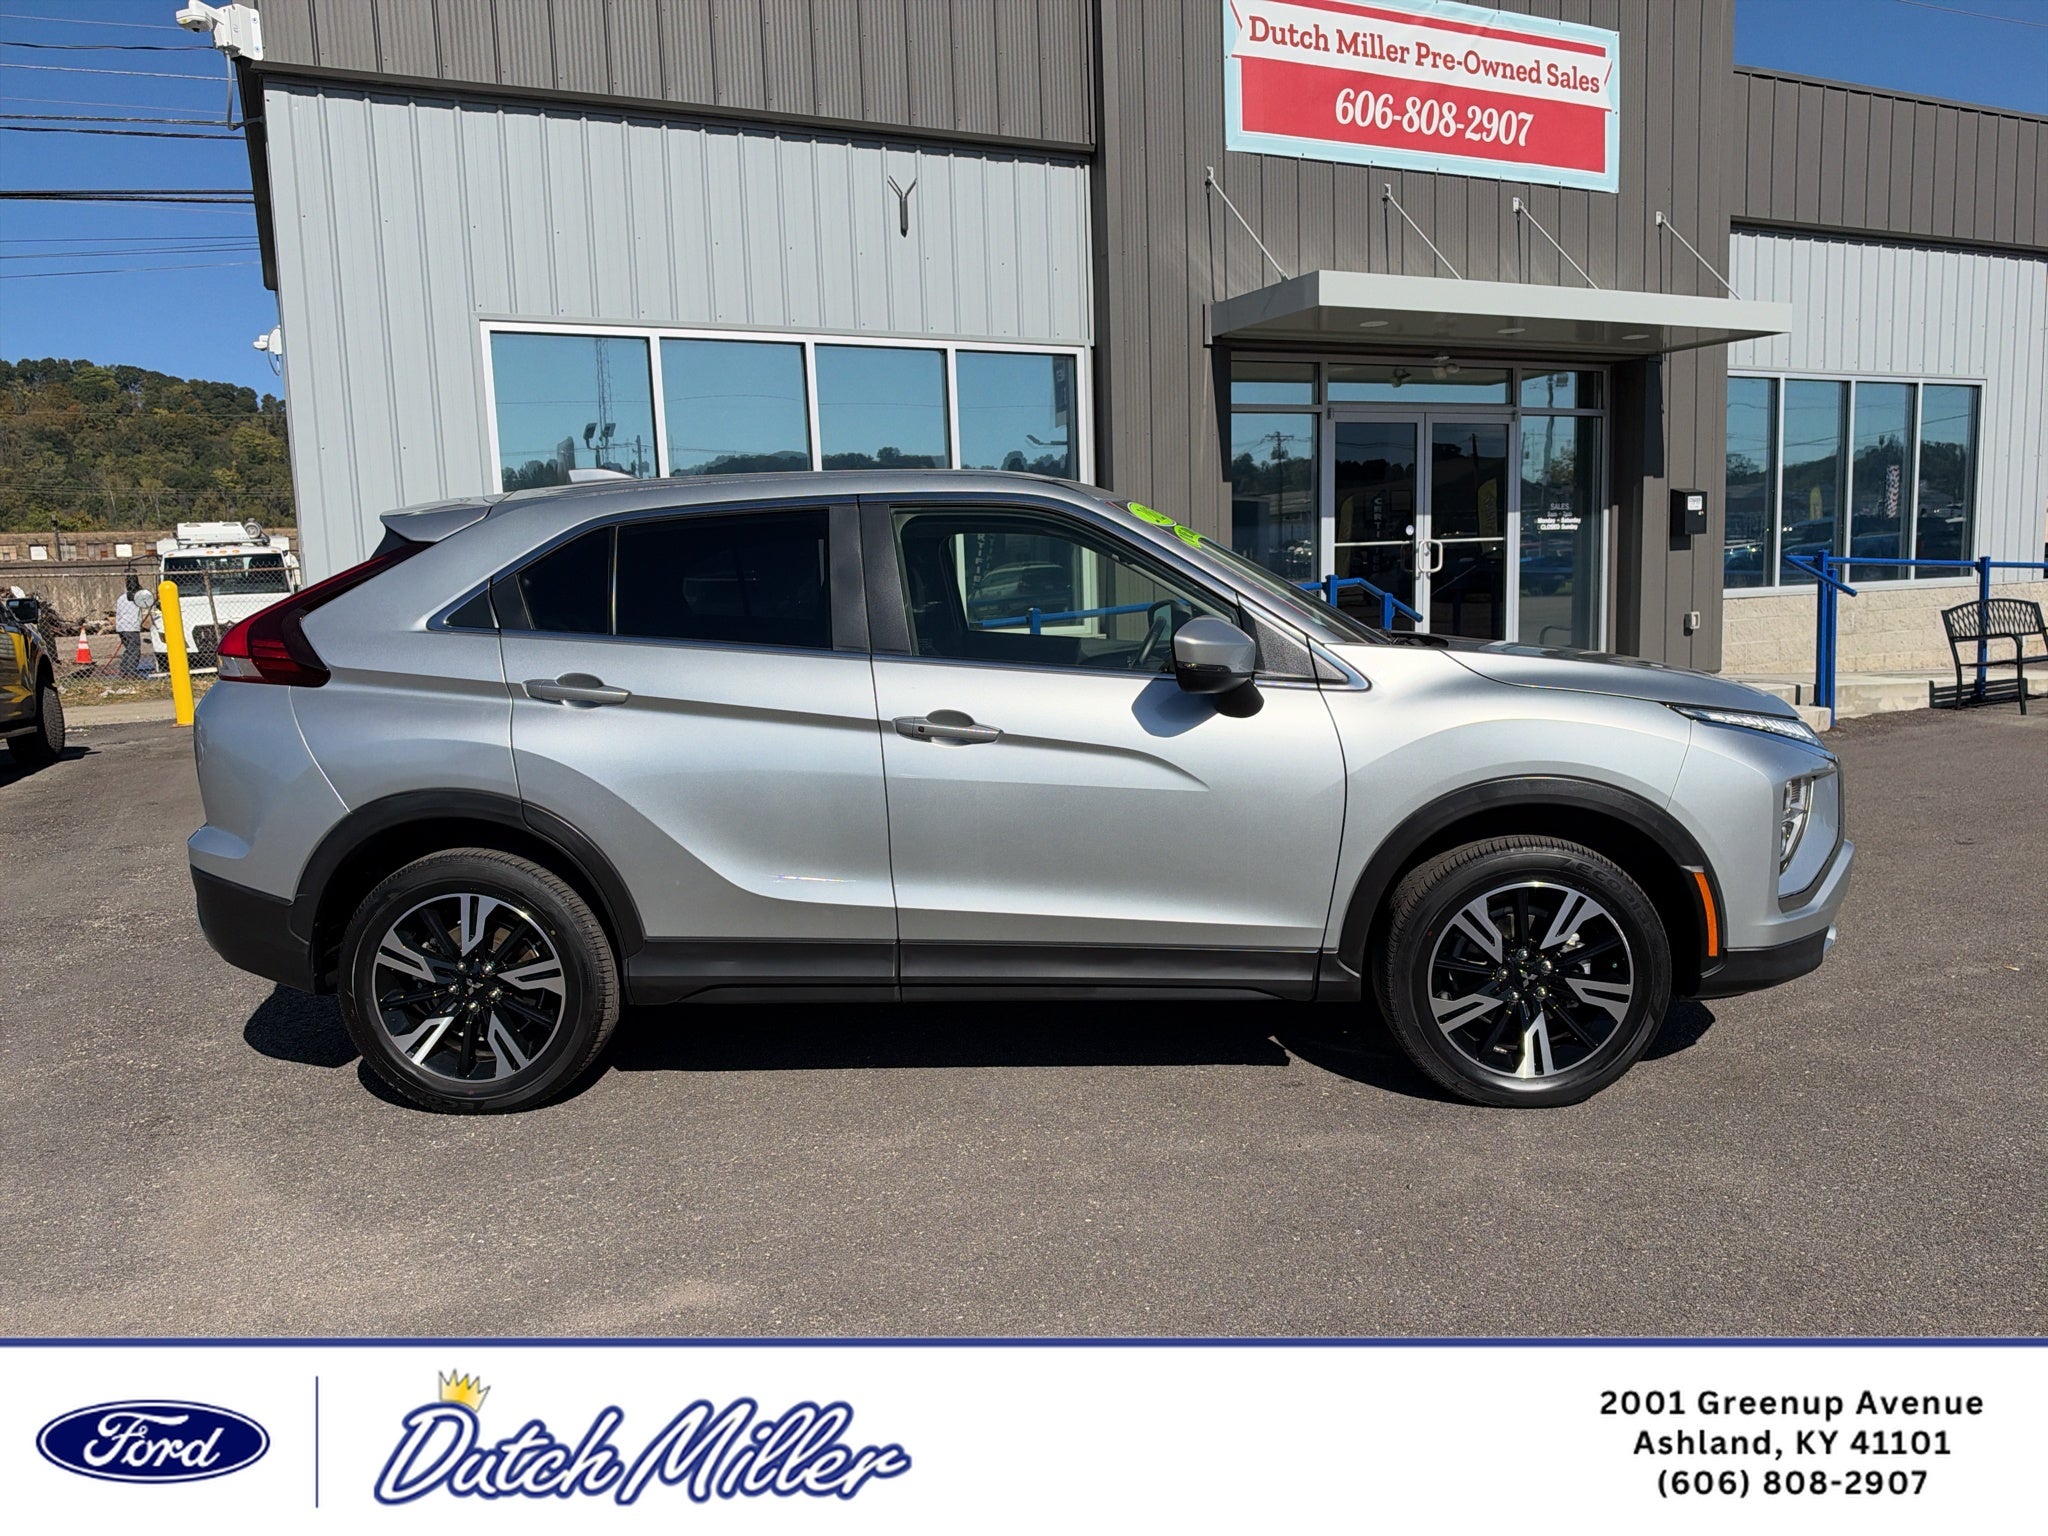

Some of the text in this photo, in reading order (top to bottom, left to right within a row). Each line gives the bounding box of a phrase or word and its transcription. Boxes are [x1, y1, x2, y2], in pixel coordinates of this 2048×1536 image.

[1248, 15, 1601, 94] Dutch Miller Pre-Owned Sales
[1334, 87, 1535, 147] 606-808-2907
[1550, 502, 1569, 510] SALES
